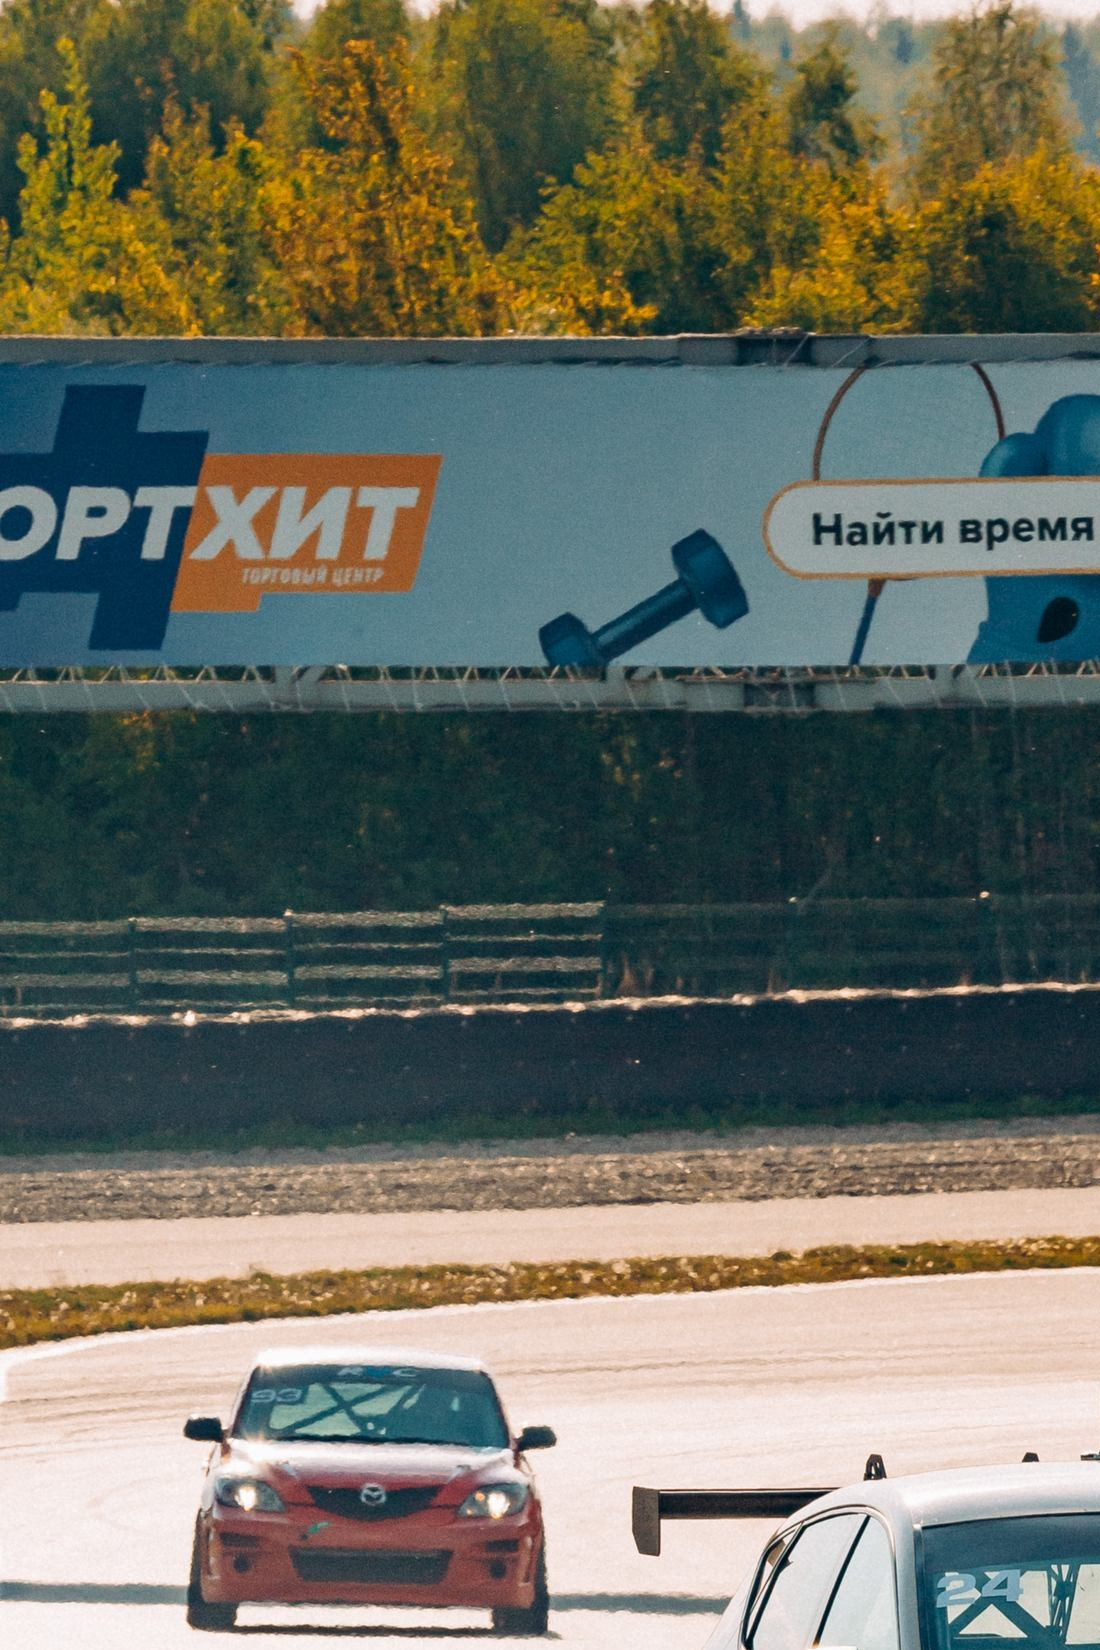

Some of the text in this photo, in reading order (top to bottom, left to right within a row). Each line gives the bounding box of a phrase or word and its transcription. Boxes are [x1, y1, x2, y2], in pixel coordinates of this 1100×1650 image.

[812, 511, 945, 546] Найти
[959, 515, 1095, 550] время
[936, 1569, 1024, 1608] 24
